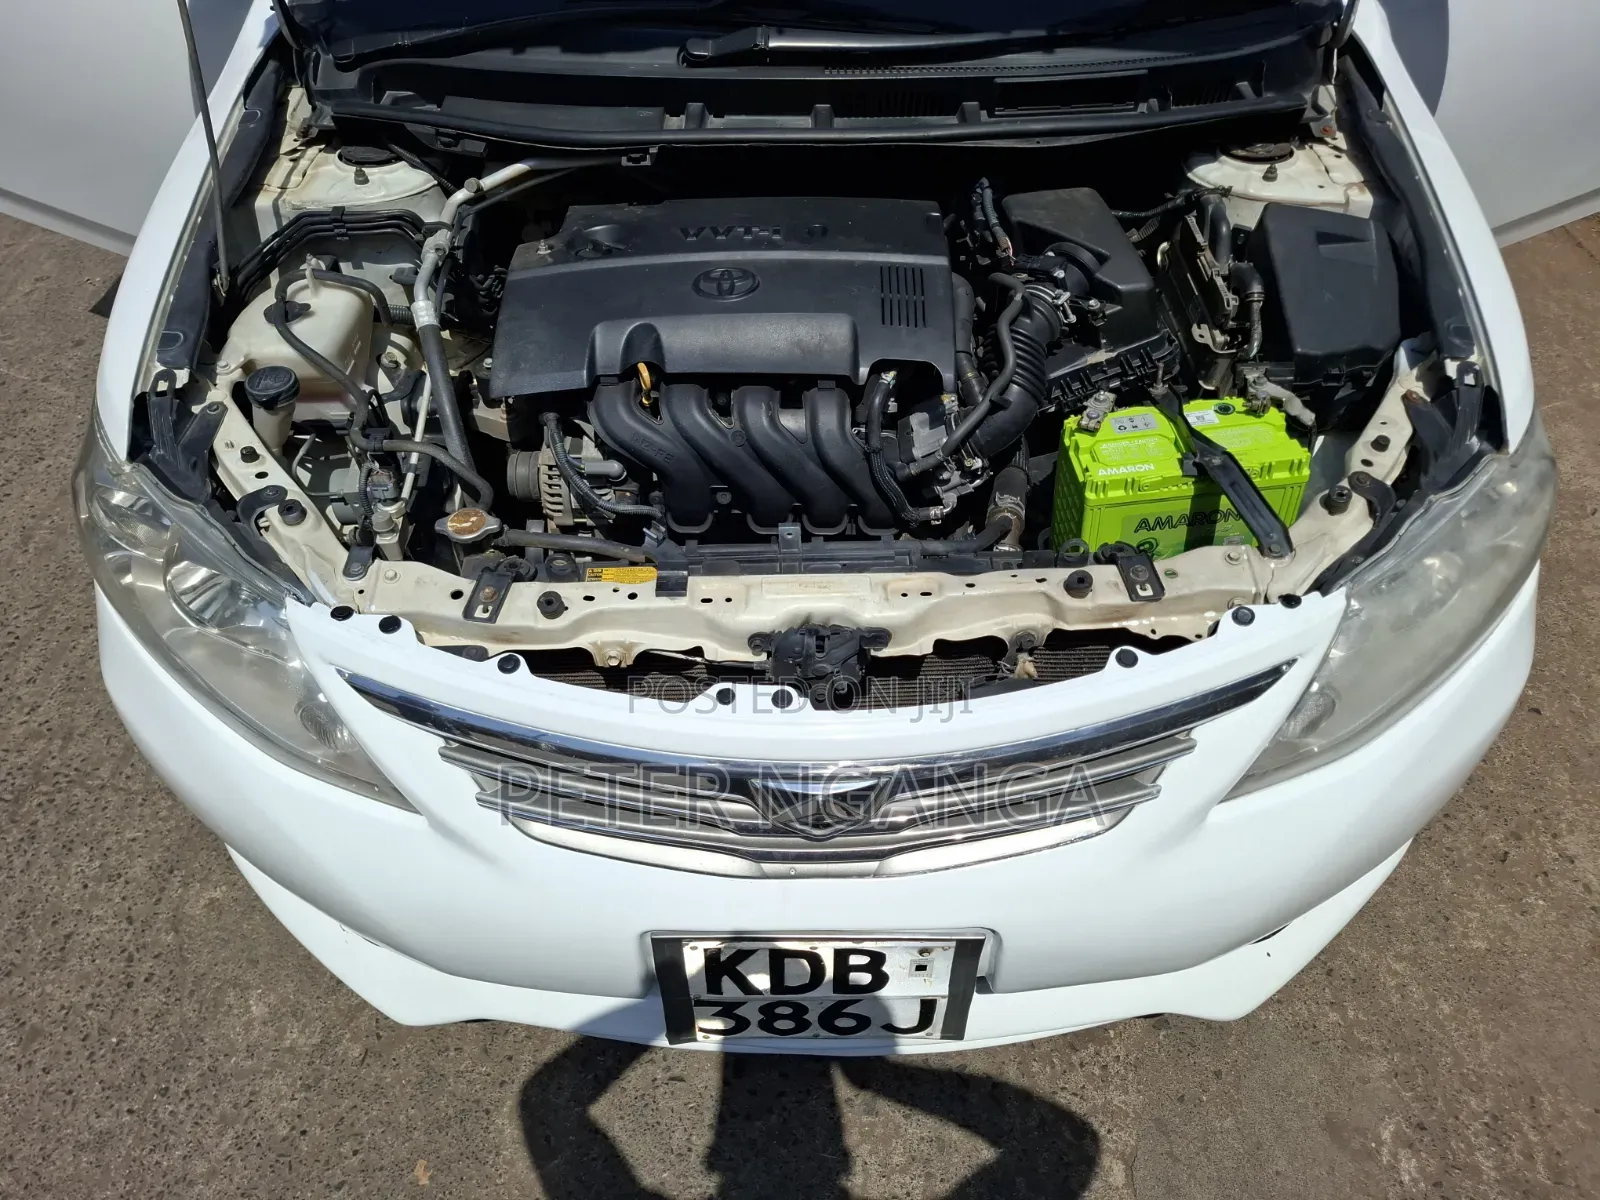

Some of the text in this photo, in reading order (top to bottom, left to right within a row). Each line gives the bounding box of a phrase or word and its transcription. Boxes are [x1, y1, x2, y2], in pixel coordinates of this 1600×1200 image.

[1097, 463, 1155, 476] AMARON
[1133, 508, 1241, 533] AMARON
[702, 947, 891, 996] KDB
[693, 999, 938, 1036] 386J
